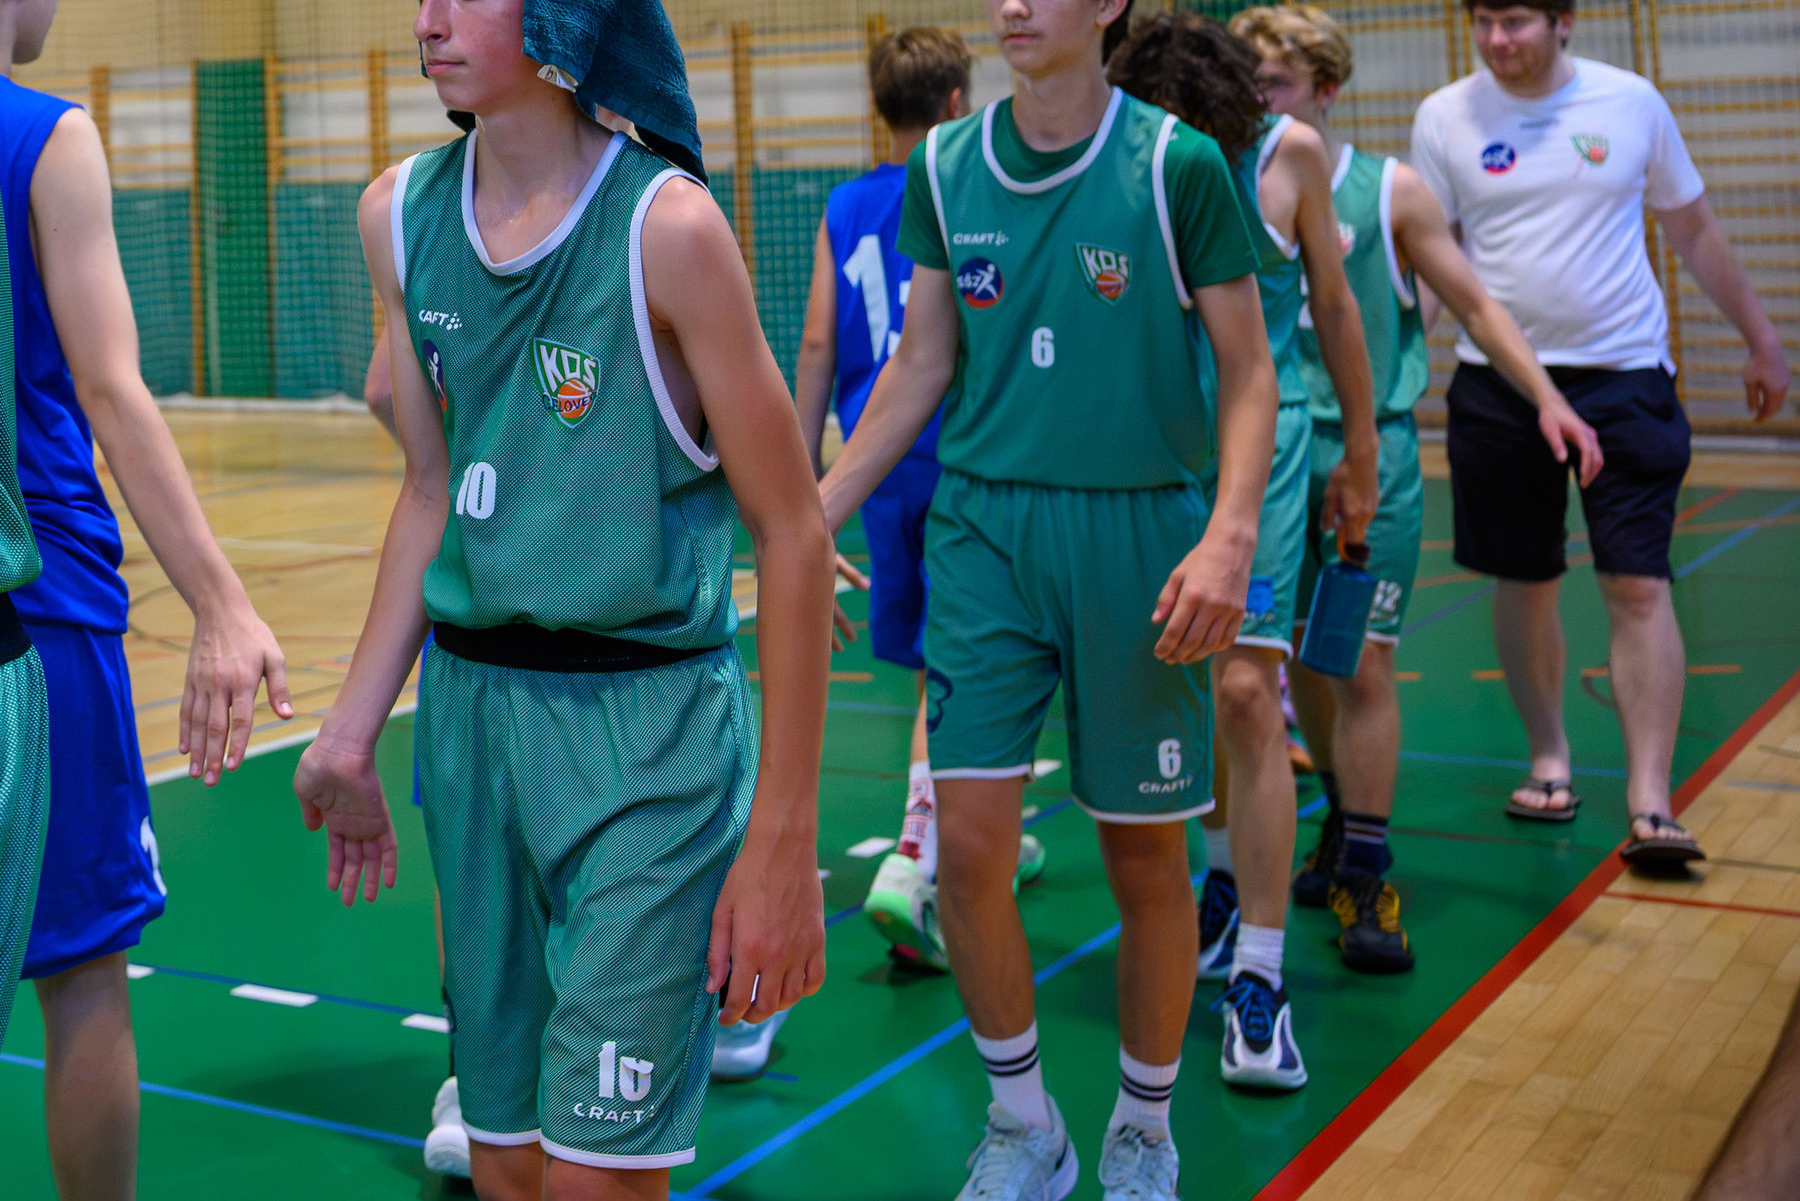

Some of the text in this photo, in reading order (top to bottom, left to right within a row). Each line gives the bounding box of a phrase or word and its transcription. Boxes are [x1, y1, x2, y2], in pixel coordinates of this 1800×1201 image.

[1031, 326, 1055, 369] 6
[455, 462, 497, 520] 10
[1157, 738, 1182, 779] 6
[573, 1102, 644, 1123] CRAFT
